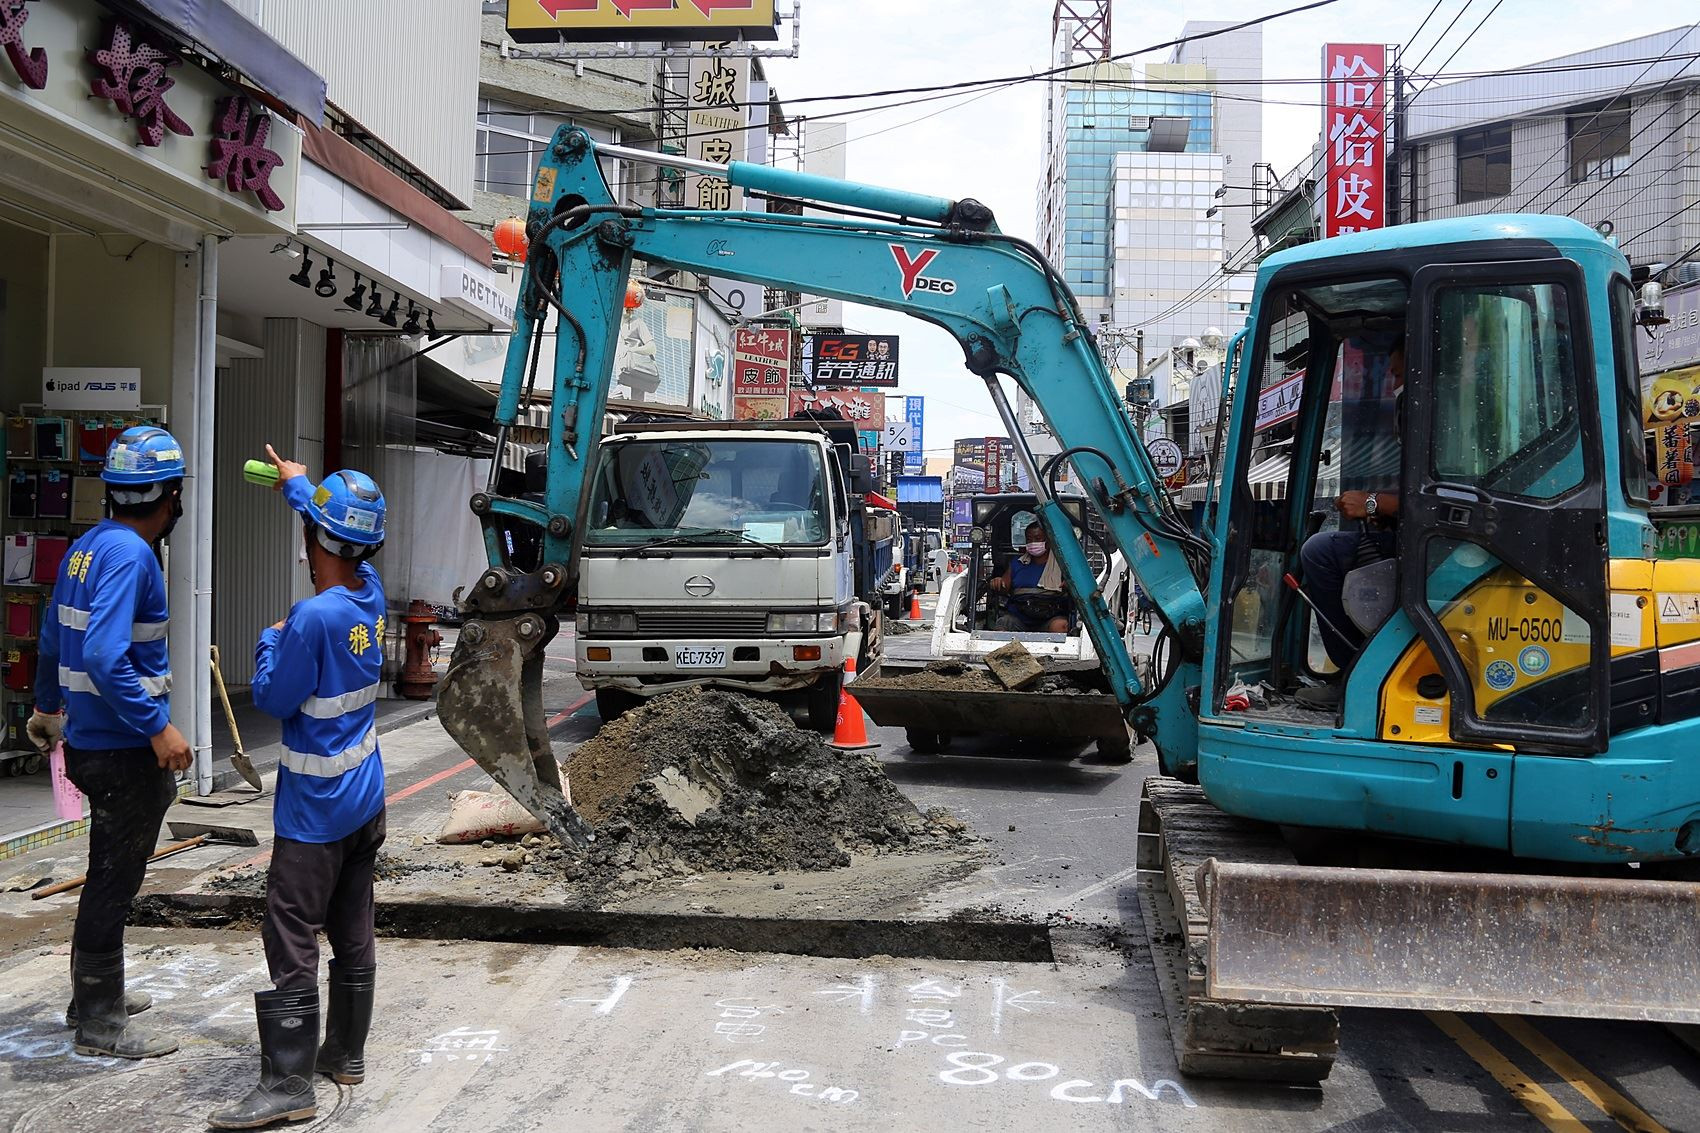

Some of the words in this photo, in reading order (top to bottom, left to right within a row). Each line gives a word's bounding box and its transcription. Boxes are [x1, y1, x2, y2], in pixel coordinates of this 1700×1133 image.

[1329, 54, 1380, 237] 恰恰皮
[462, 271, 505, 315] PRETTY
[739, 331, 785, 357] 紅牛城
[744, 354, 779, 366] LEATHER
[816, 360, 896, 380] 吉吉通訊
[742, 367, 781, 384] 皮飾
[57, 381, 80, 393] ipad
[83, 382, 117, 391] ASUS
[1487, 616, 1562, 643] MU-0500
[675, 651, 725, 665] KEC-7397
